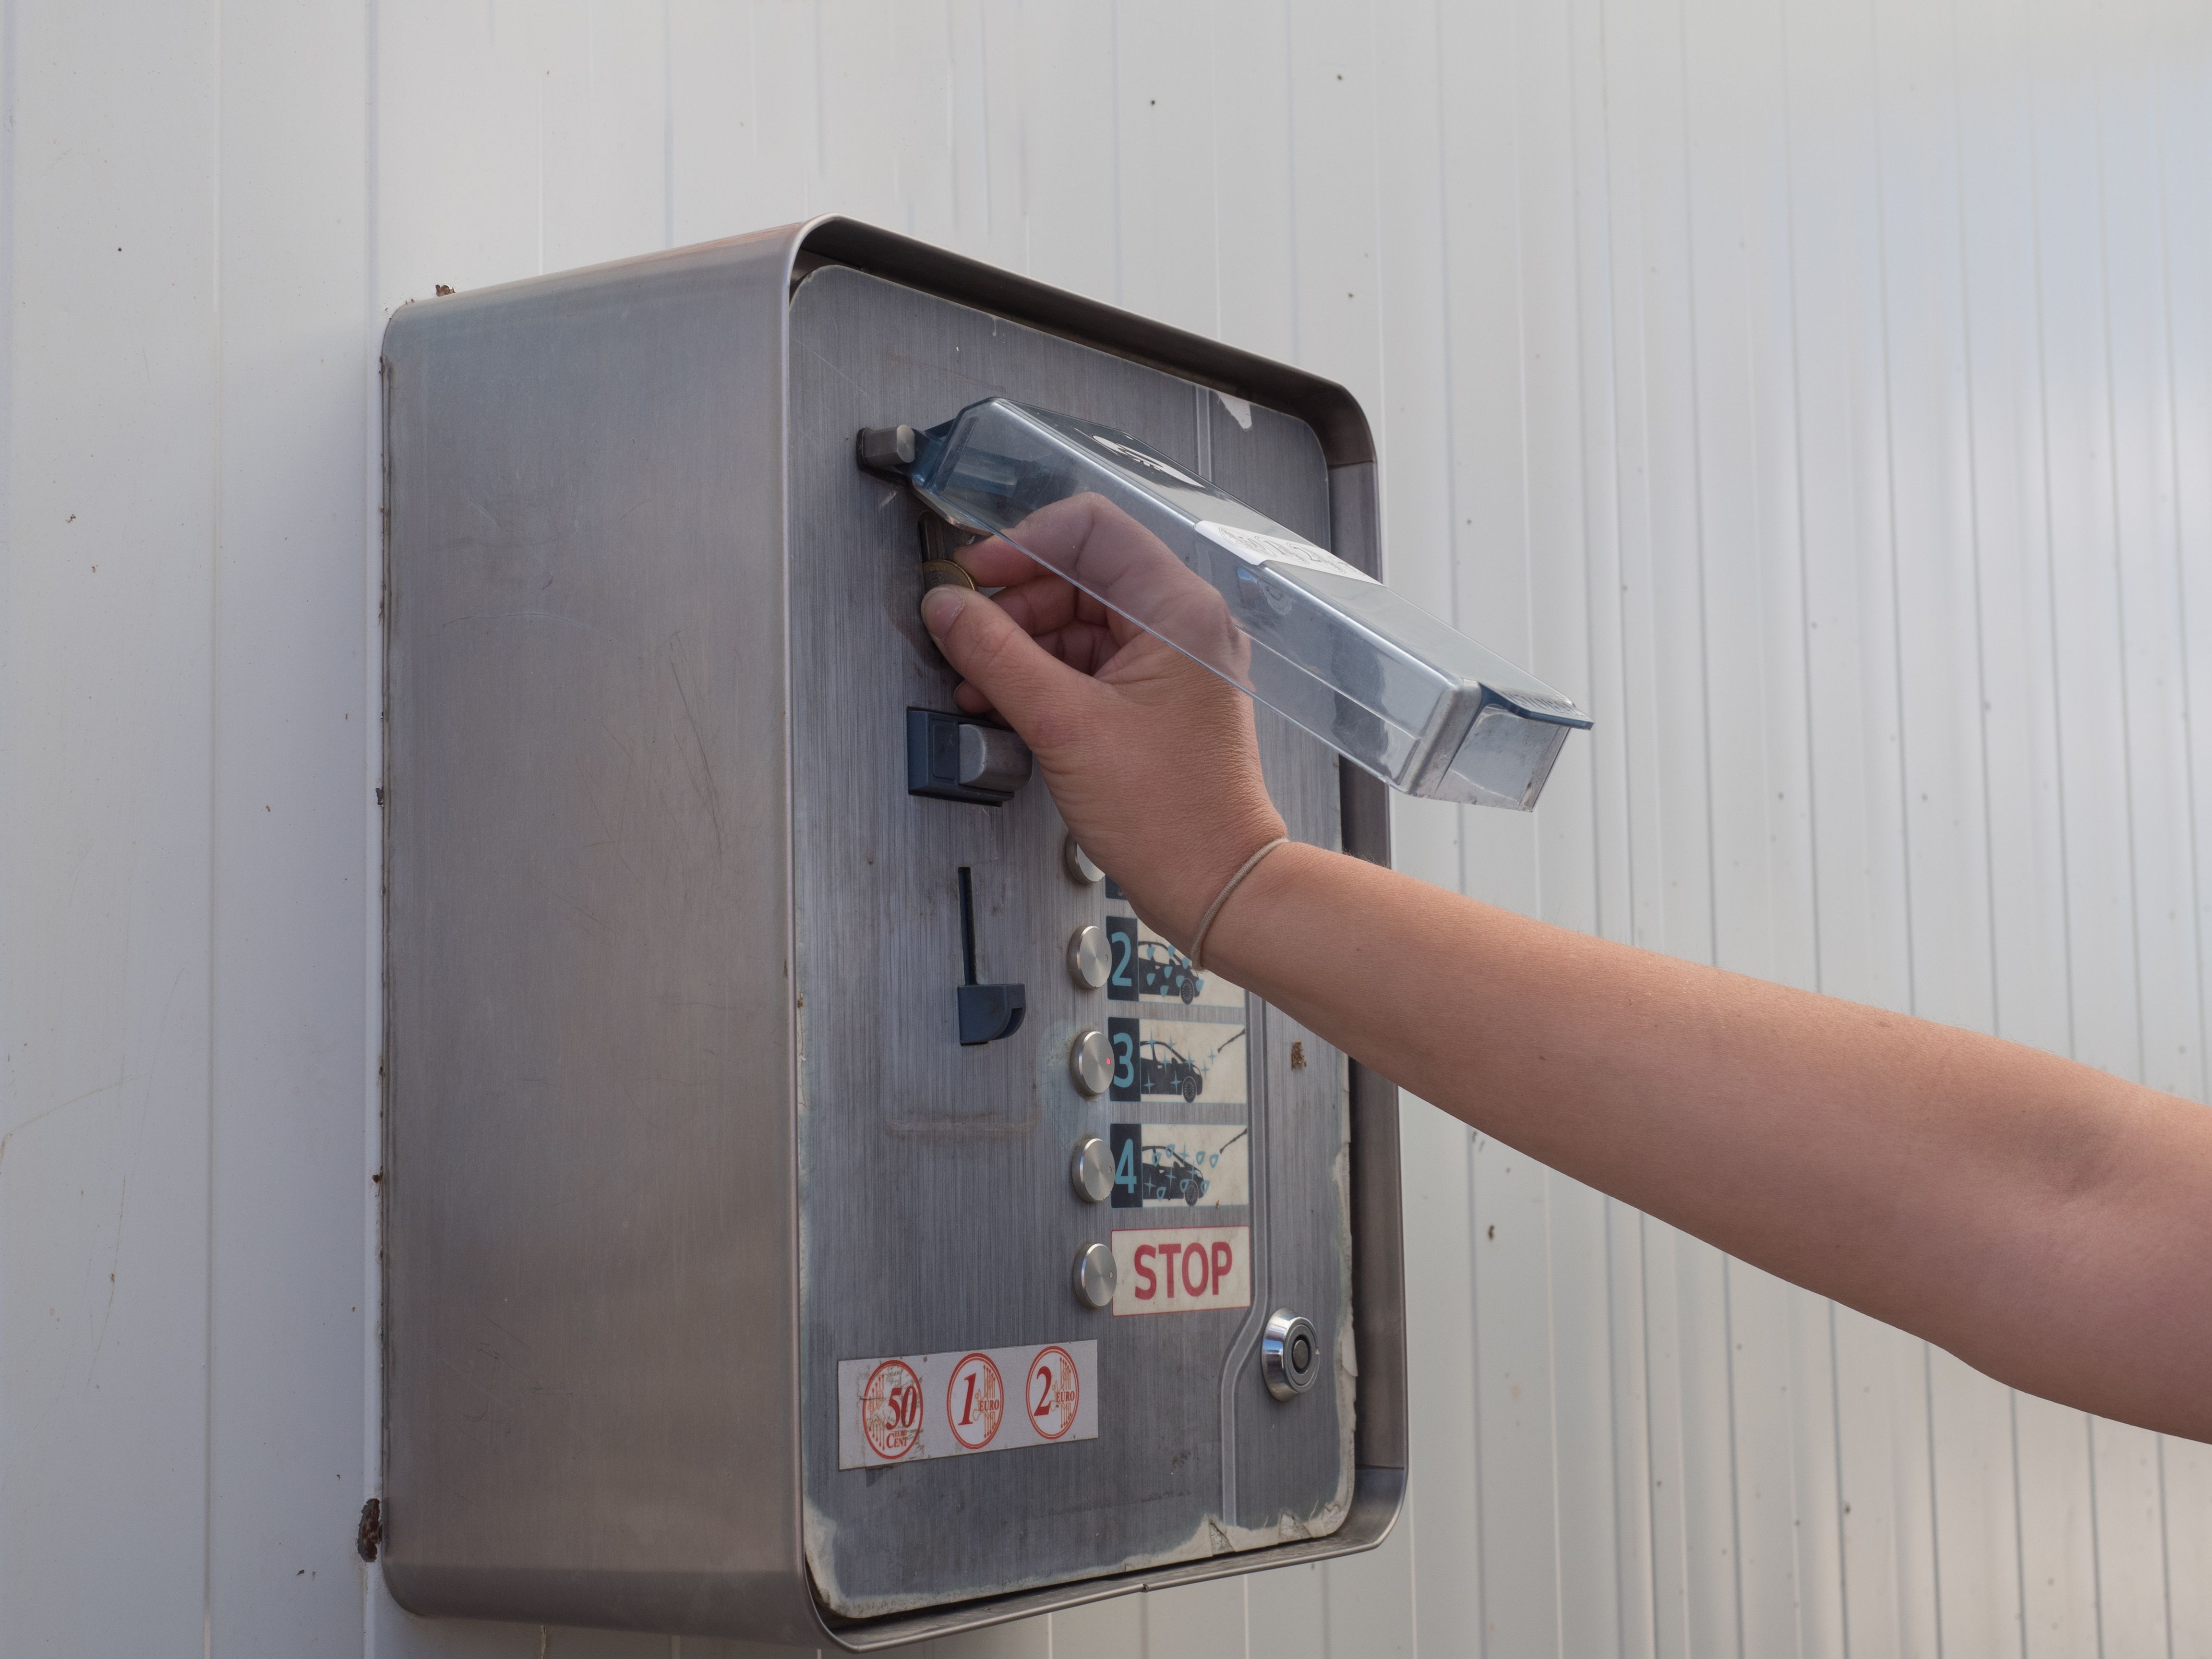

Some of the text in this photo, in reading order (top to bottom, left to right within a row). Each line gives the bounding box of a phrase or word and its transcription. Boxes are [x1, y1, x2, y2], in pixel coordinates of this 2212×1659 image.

[1111, 931, 1132, 987] 2
[1113, 1032, 1134, 1088] 3
[1114, 1138, 1137, 1194] 4
[1134, 1241, 1233, 1300] STOP
[886, 1385, 917, 1430] 50
[958, 1373, 999, 1426] 1 EURO
[1034, 1366, 1075, 1417] 2 EURO
